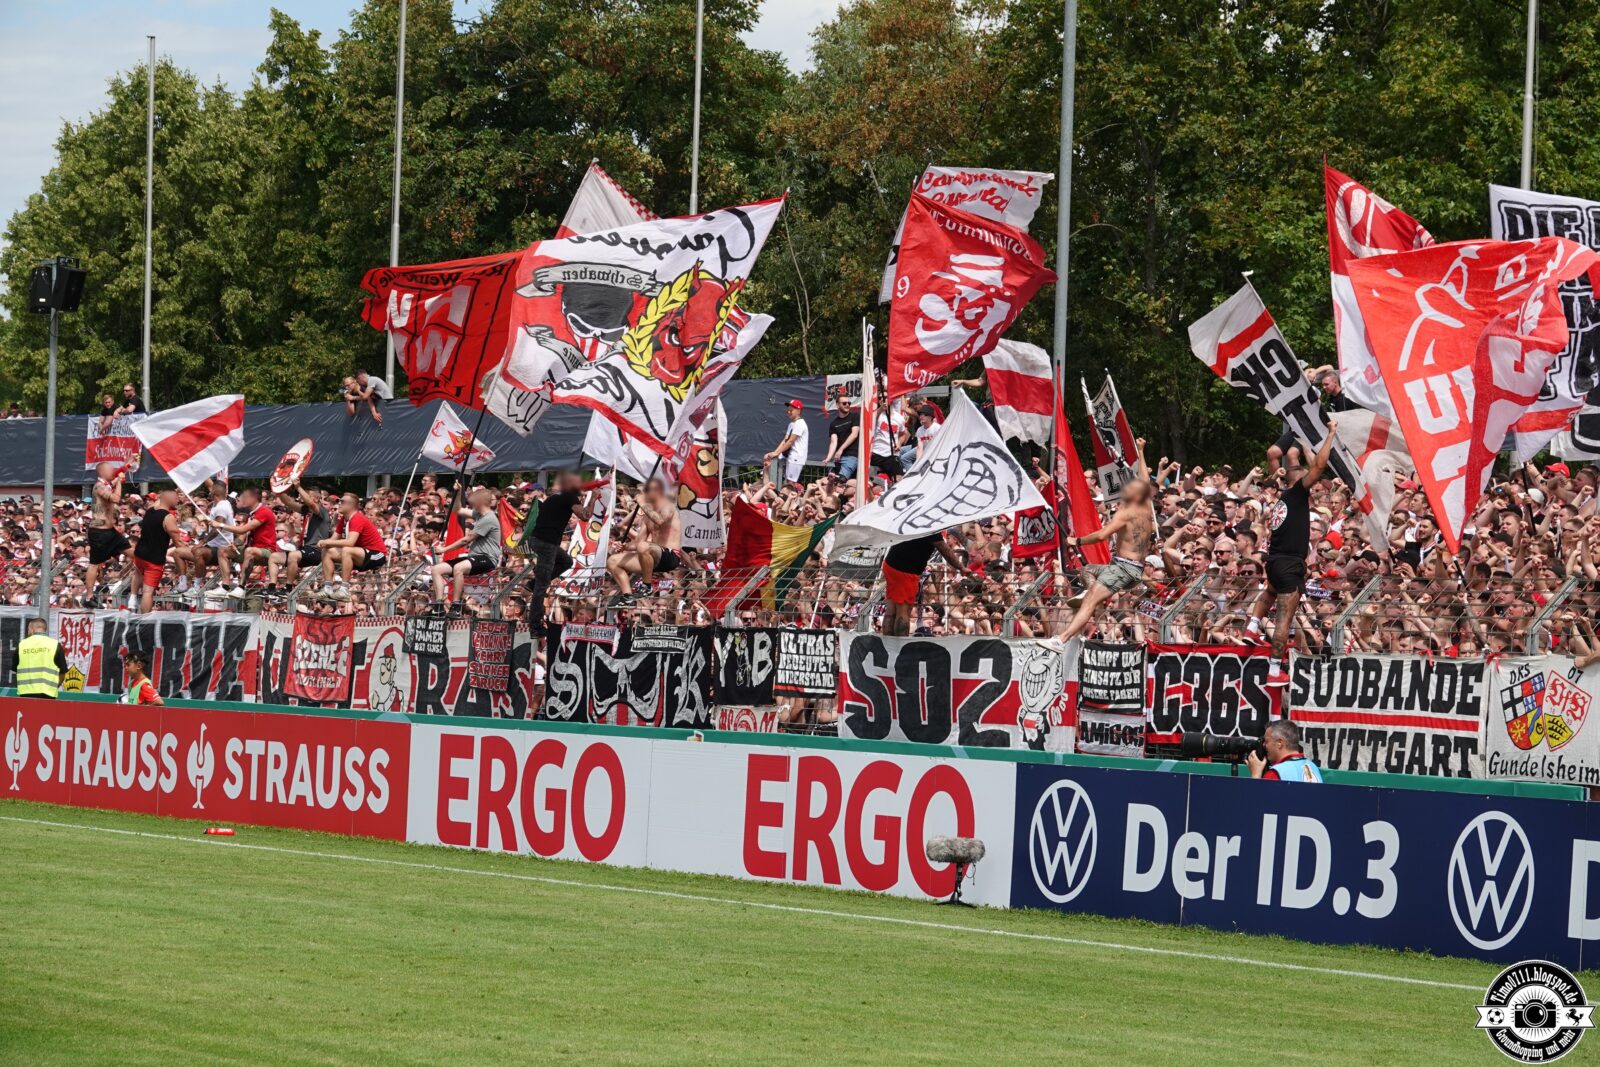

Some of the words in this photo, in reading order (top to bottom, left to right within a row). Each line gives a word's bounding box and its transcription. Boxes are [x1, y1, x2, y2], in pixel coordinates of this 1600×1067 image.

[428, 619, 446, 631] BIST
[415, 629, 444, 644] IMMER
[780, 631, 835, 656] ULTRAS
[22, 647, 52, 655] SECURITY
[1083, 647, 1120, 668] KAMPF
[778, 652, 834, 673] BEDEUTET
[777, 669, 835, 688] WIDERSTAND
[1083, 668, 1122, 687] EINSATZ
[1509, 663, 1531, 685] DKS
[1567, 666, 1584, 684] 07
[1299, 726, 1479, 779] TUTTGART
[36, 724, 178, 794] STRAUSS
[222, 736, 391, 815] STRAUSS
[1488, 750, 1600, 785] Gundelsheim
[436, 733, 627, 862] ERGO
[742, 753, 976, 899] ERGO
[1121, 802, 1242, 903] Der
[1256, 813, 1401, 919] ID.3
